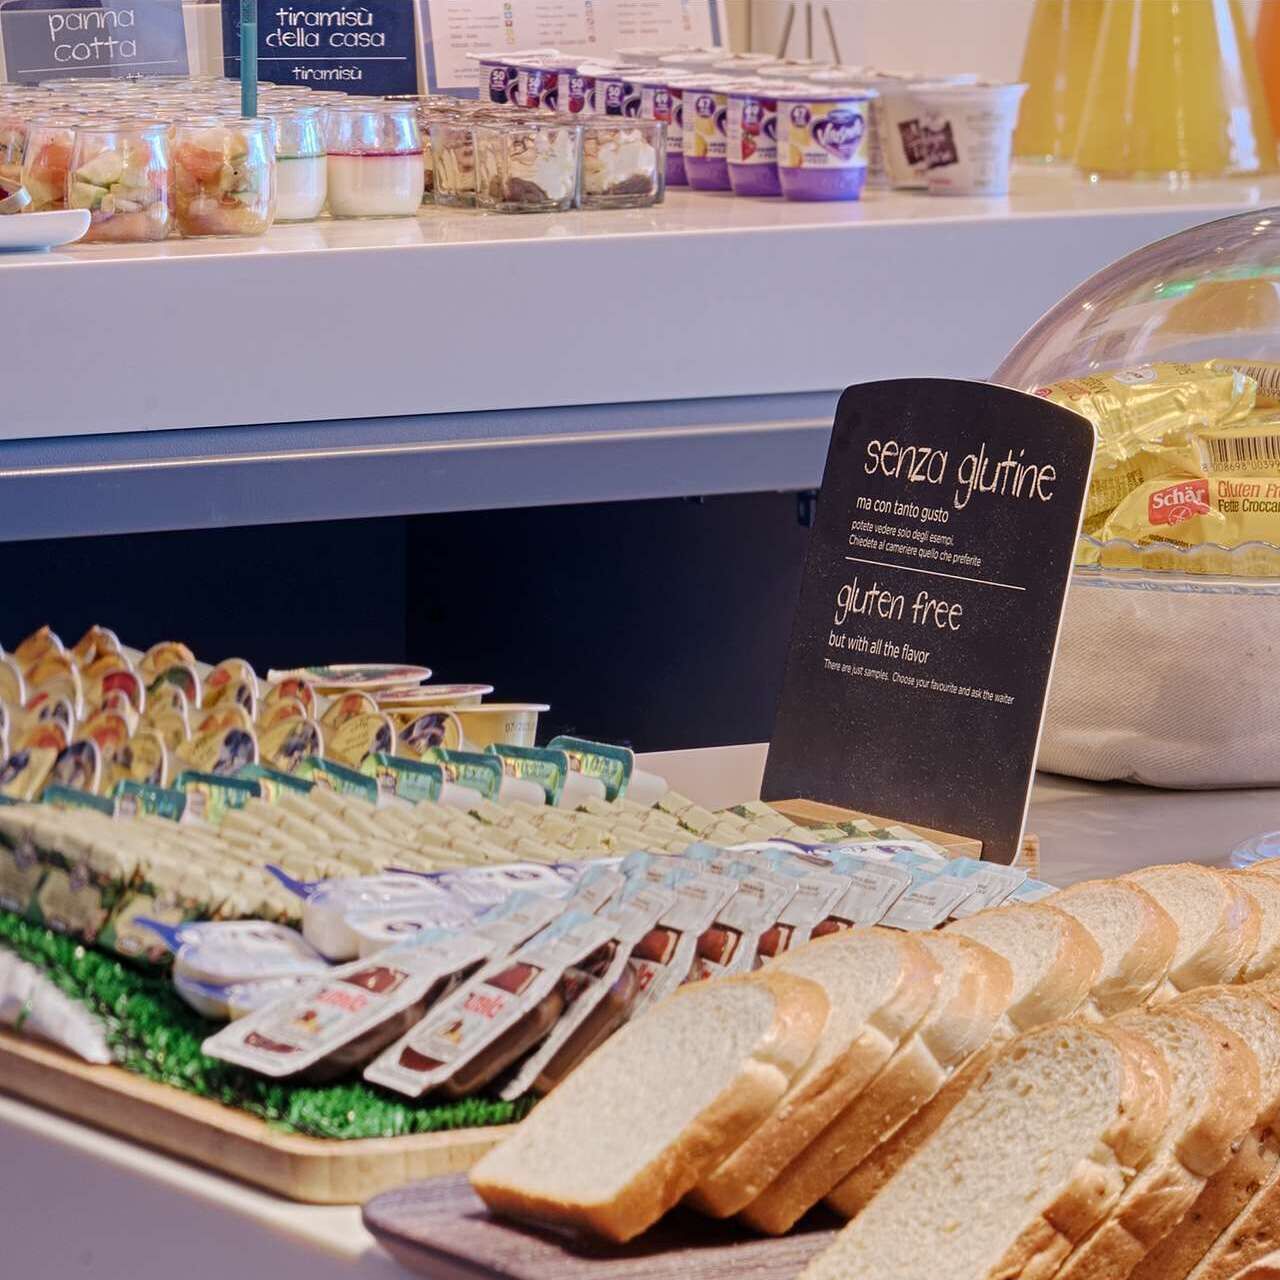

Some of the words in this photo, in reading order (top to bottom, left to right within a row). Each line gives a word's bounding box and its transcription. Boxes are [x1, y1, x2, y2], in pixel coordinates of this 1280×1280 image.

[48, 9, 136, 42] panna
[276, 7, 373, 27] tiramisù
[54, 36, 137, 62] cotta
[265, 28, 320, 48] della
[329, 32, 385, 48] casa
[292, 66, 363, 81] tiramisù
[864, 439, 949, 486] senza
[953, 442, 1057, 510] glutine
[1152, 486, 1206, 510] Schär
[1217, 480, 1261, 498] Gluten
[856, 496, 872, 510] ma
[873, 498, 892, 514] con
[893, 500, 920, 518] tanto
[920, 507, 950, 523] gusto
[851, 520, 874, 532] potete
[874, 523, 896, 536] vedere
[897, 526, 912, 539] solo
[912, 528, 929, 543] degli
[848, 533, 878, 550] Chiedete
[878, 539, 886, 551] al
[918, 546, 939, 561] quello
[940, 549, 952, 564] che
[834, 576, 905, 626] gluten
[911, 589, 963, 631] free
[828, 629, 846, 648] but
[847, 634, 869, 653] with
[869, 637, 882, 656] all
[883, 640, 900, 659] the
[900, 643, 930, 665] flavor
[841, 662, 852, 674] are
[850, 662, 864, 678] just
[892, 671, 916, 686] Choose
[915, 676, 930, 690] your
[930, 678, 958, 695] favourite
[958, 682, 971, 697] and
[970, 684, 982, 699] ask
[982, 687, 994, 702] the
[994, 690, 1015, 706] waiter
